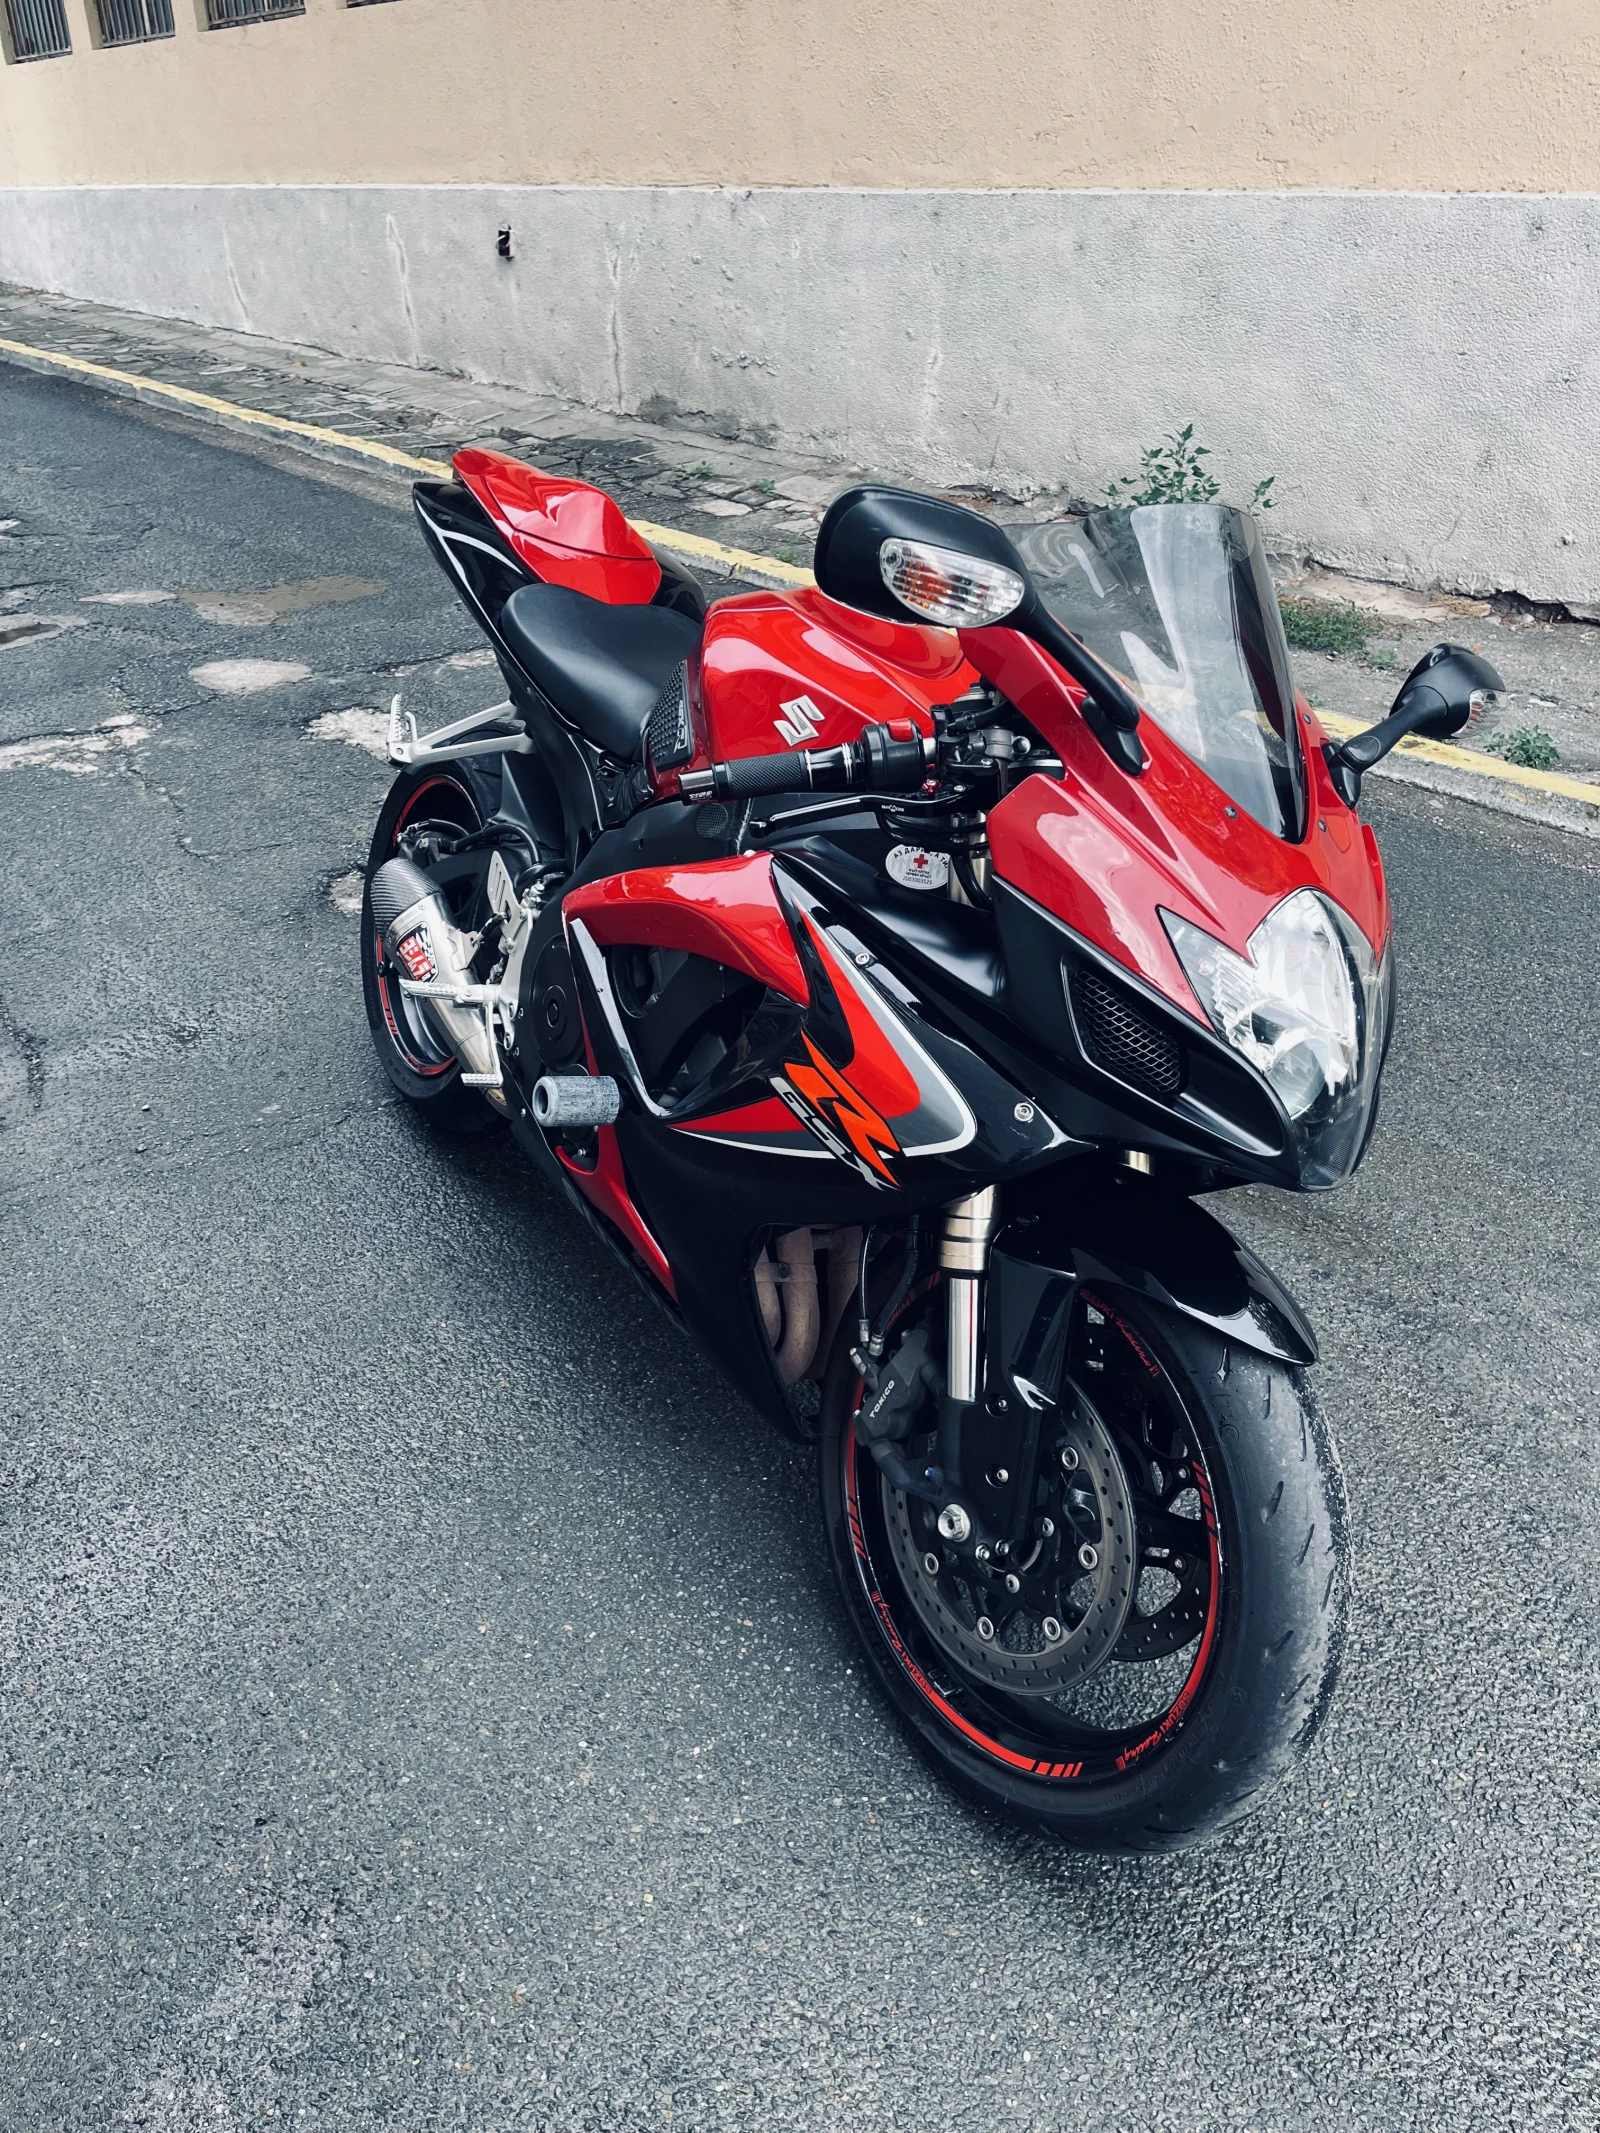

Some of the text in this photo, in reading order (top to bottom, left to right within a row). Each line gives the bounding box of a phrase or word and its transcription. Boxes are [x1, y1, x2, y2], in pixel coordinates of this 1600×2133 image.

[894, 850, 903, 859] АЗ
[904, 846, 932, 857] ДАРИ,
[869, 1379, 895, 1419] TOKICO
[878, 1602, 932, 1695] SUZUKI Racing
[1159, 1691, 1192, 1734] SUZUKI
[1124, 1731, 1162, 1762] Racing
